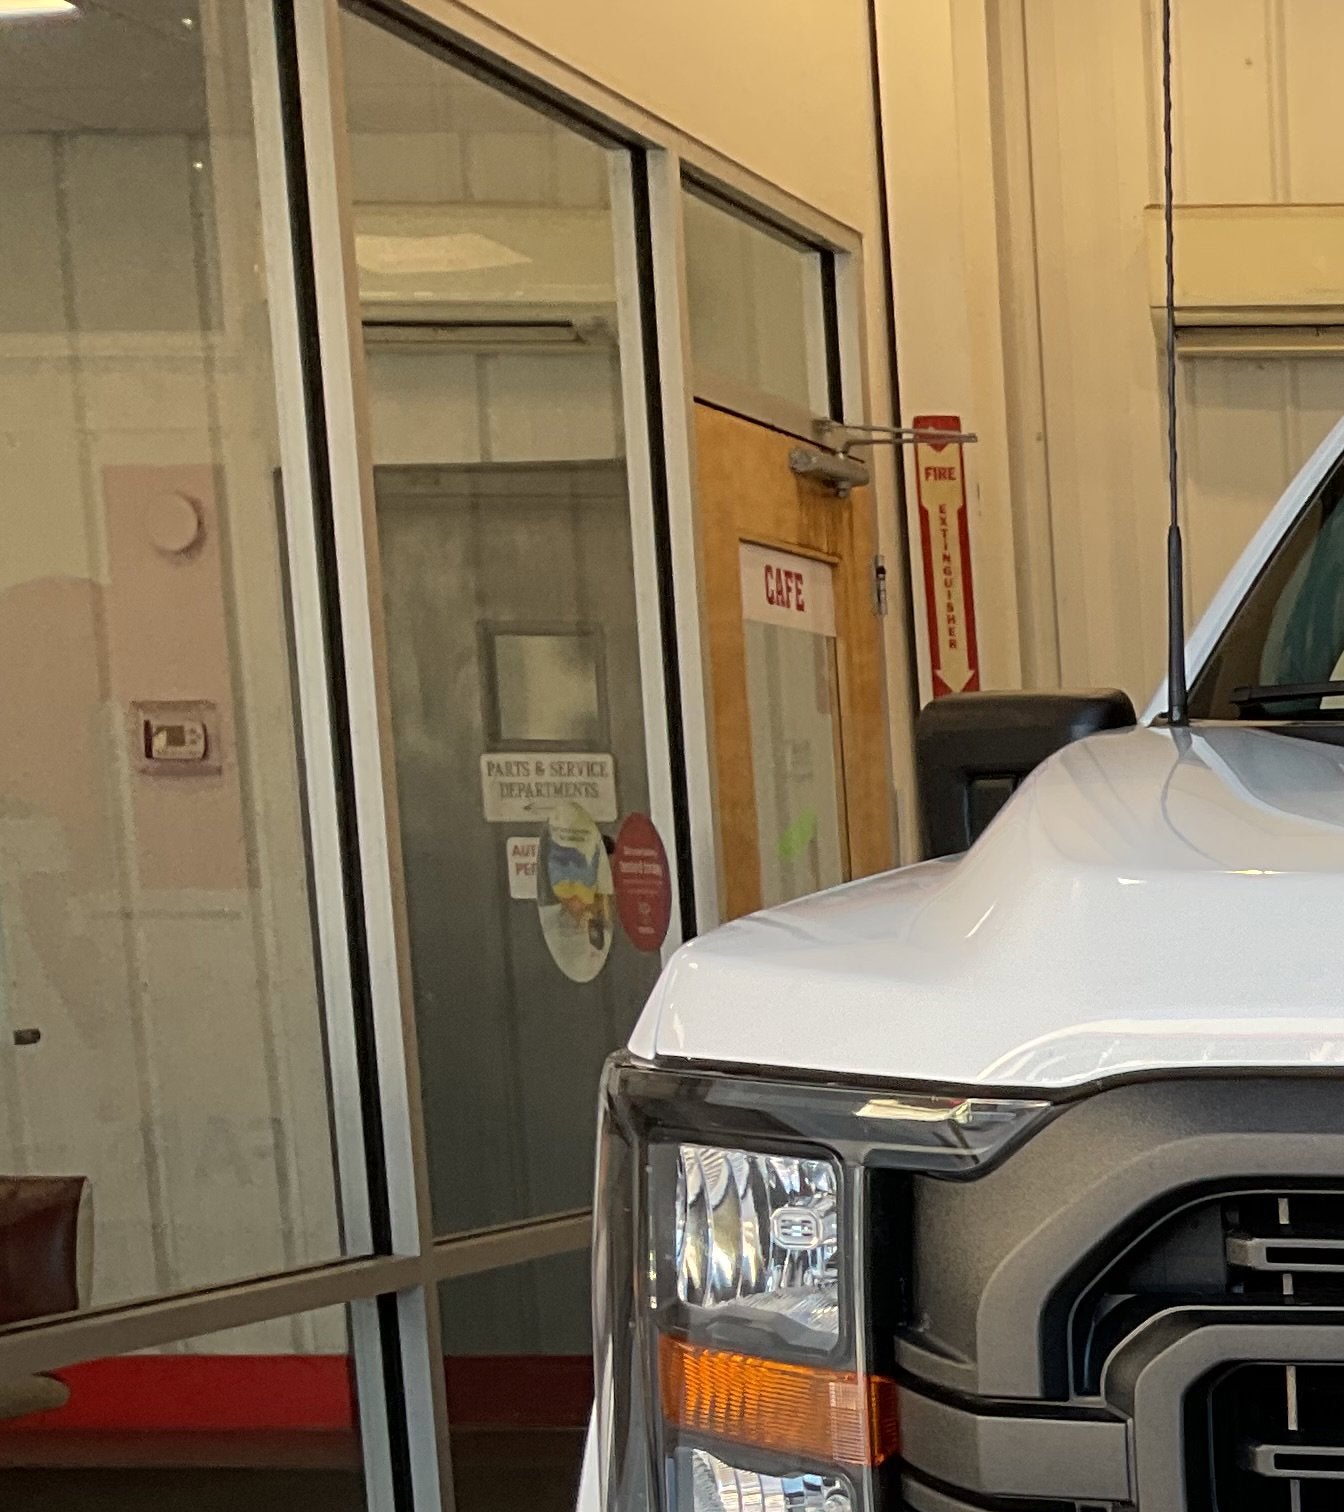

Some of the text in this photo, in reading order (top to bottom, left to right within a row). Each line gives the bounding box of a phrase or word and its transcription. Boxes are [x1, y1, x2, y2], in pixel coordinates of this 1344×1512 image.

[925, 467, 956, 480] FIRE
[939, 504, 957, 648] EXTINGUISHER
[765, 565, 805, 611] CAFE
[487, 761, 608, 777] PARTS & SERVICE
[500, 782, 599, 798] DEPARTMENTS
